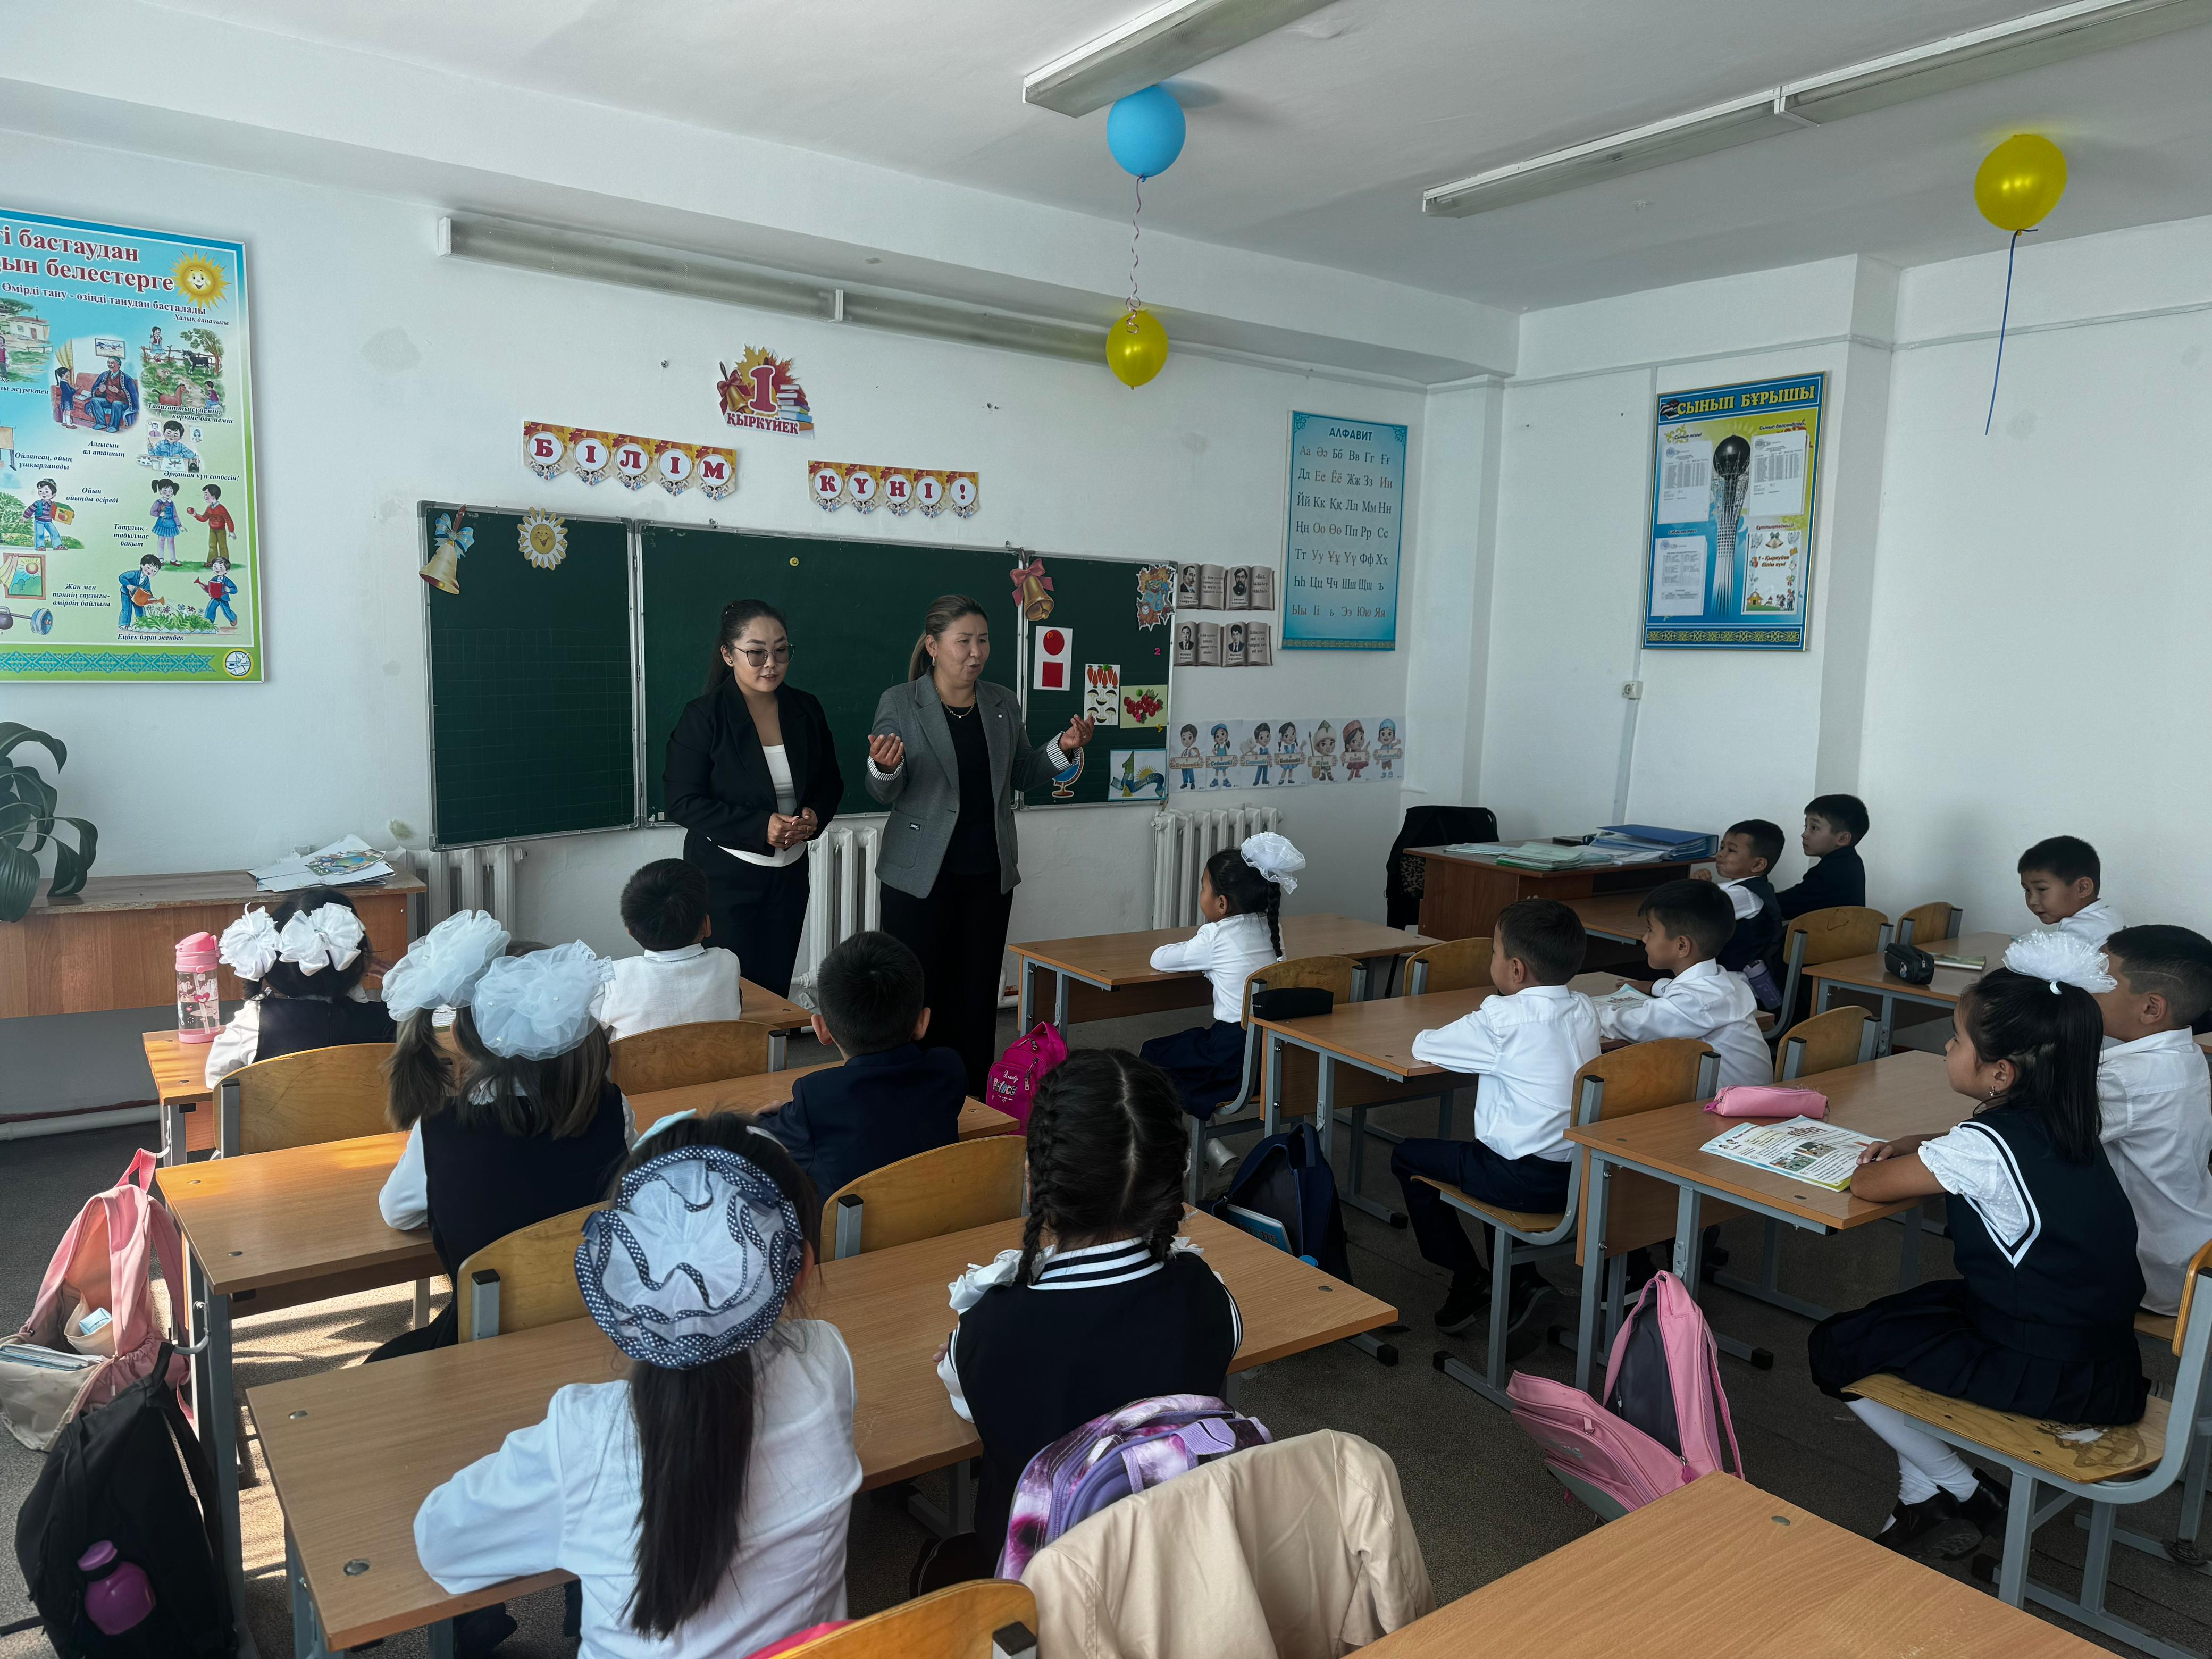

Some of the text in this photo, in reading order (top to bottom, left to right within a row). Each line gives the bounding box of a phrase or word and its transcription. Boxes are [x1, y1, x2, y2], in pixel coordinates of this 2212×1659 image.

[19, 229, 139, 262] бастаудан
[47, 259, 173, 292] белестерге
[2, 283, 39, 296] Өмірді
[42, 289, 66, 300] тану
[77, 293, 106, 304] өзіңді
[110, 297, 150, 308] танудан
[153, 301, 206, 315] басталады
[174, 314, 196, 323] Халық
[749, 367, 776, 412] 1
[148, 403, 189, 412] Табиғатты
[1677, 385, 1816, 415] СЫНЫП БҰРЫШЫ
[727, 412, 799, 434] ҚЫРКҮЙЕК
[1329, 427, 1372, 441] АЛФАВИТ
[88, 440, 119, 449] Алғысын
[1300, 445, 1311, 456] Аа
[1333, 448, 1343, 459] Бб
[1348, 450, 1360, 461] Вв
[1364, 452, 1375, 463] Гг
[15, 452, 52, 462] Ойлансаң,
[534, 438, 725, 480] БІЛІМ
[819, 475, 966, 500] КҮНІ!
[1298, 468, 1393, 489] Дд Ее Ёё Жж Зз Ии
[1297, 492, 1310, 507] Йй
[1313, 497, 1325, 508] Кк
[1345, 499, 1358, 511] Лл
[1362, 501, 1376, 513] Мм
[1378, 502, 1392, 514] Нн
[1313, 523, 1325, 534] Оо
[1329, 524, 1342, 535] Өө
[1345, 525, 1358, 537] Пп
[1361, 526, 1372, 540] Рр
[1377, 527, 1388, 538] Сс
[1295, 548, 1388, 567] Тт Уу Ұұ Үү Фф Хх
[1310, 576, 1323, 589] Цц
[1327, 577, 1338, 589] Чч
[1342, 578, 1356, 589] Шш
[1359, 579, 1372, 591] Щщ
[1292, 605, 1307, 615] Ыы
[1341, 606, 1352, 617] Ээ
[1357, 606, 1371, 617] Юю
[1374, 607, 1386, 617] Яя
